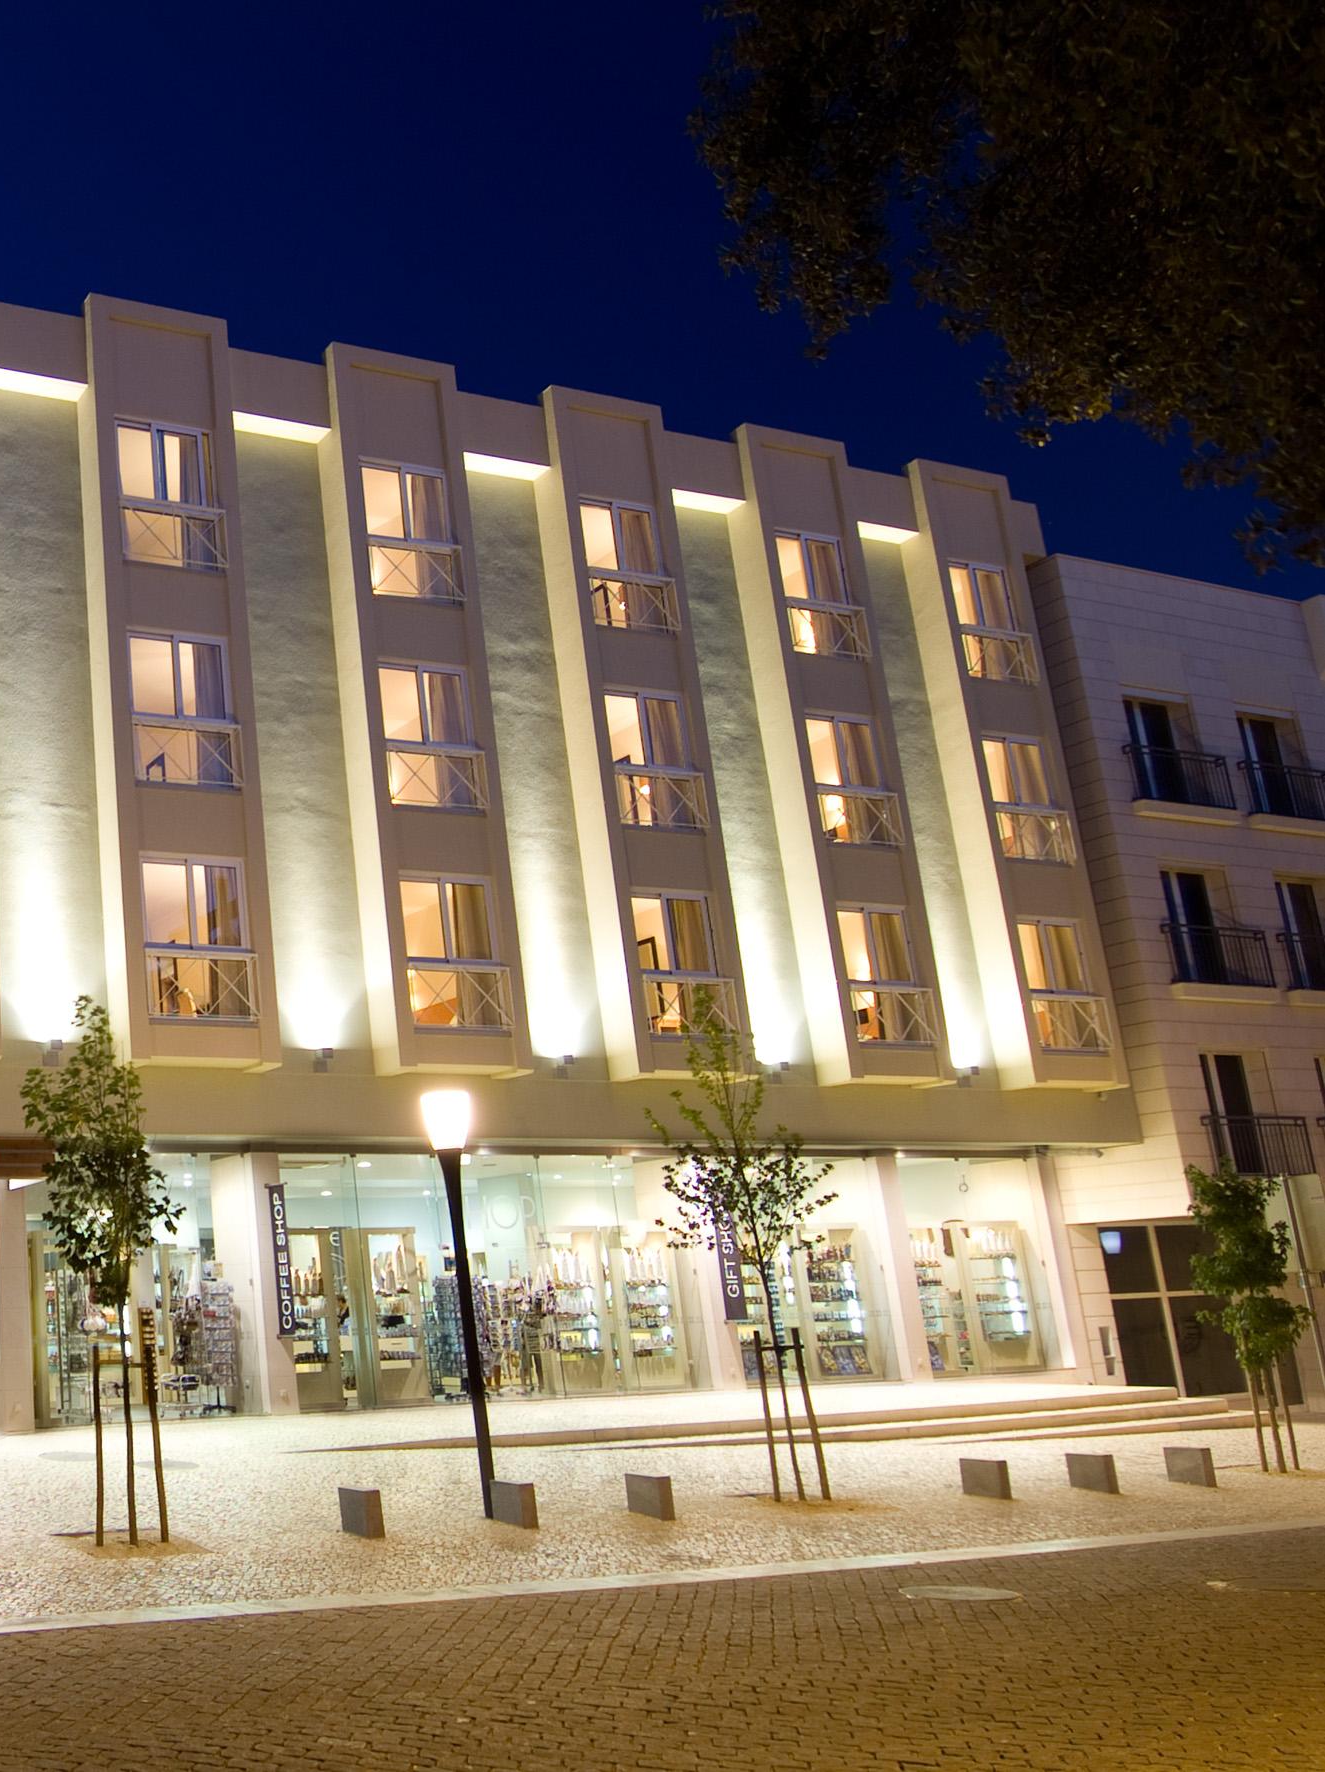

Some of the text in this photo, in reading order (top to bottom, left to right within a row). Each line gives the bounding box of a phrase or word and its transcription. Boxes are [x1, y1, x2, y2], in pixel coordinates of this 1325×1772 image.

[272, 1192, 293, 1330] COFFEE SHOP
[717, 1207, 740, 1298] GIFT SHO
